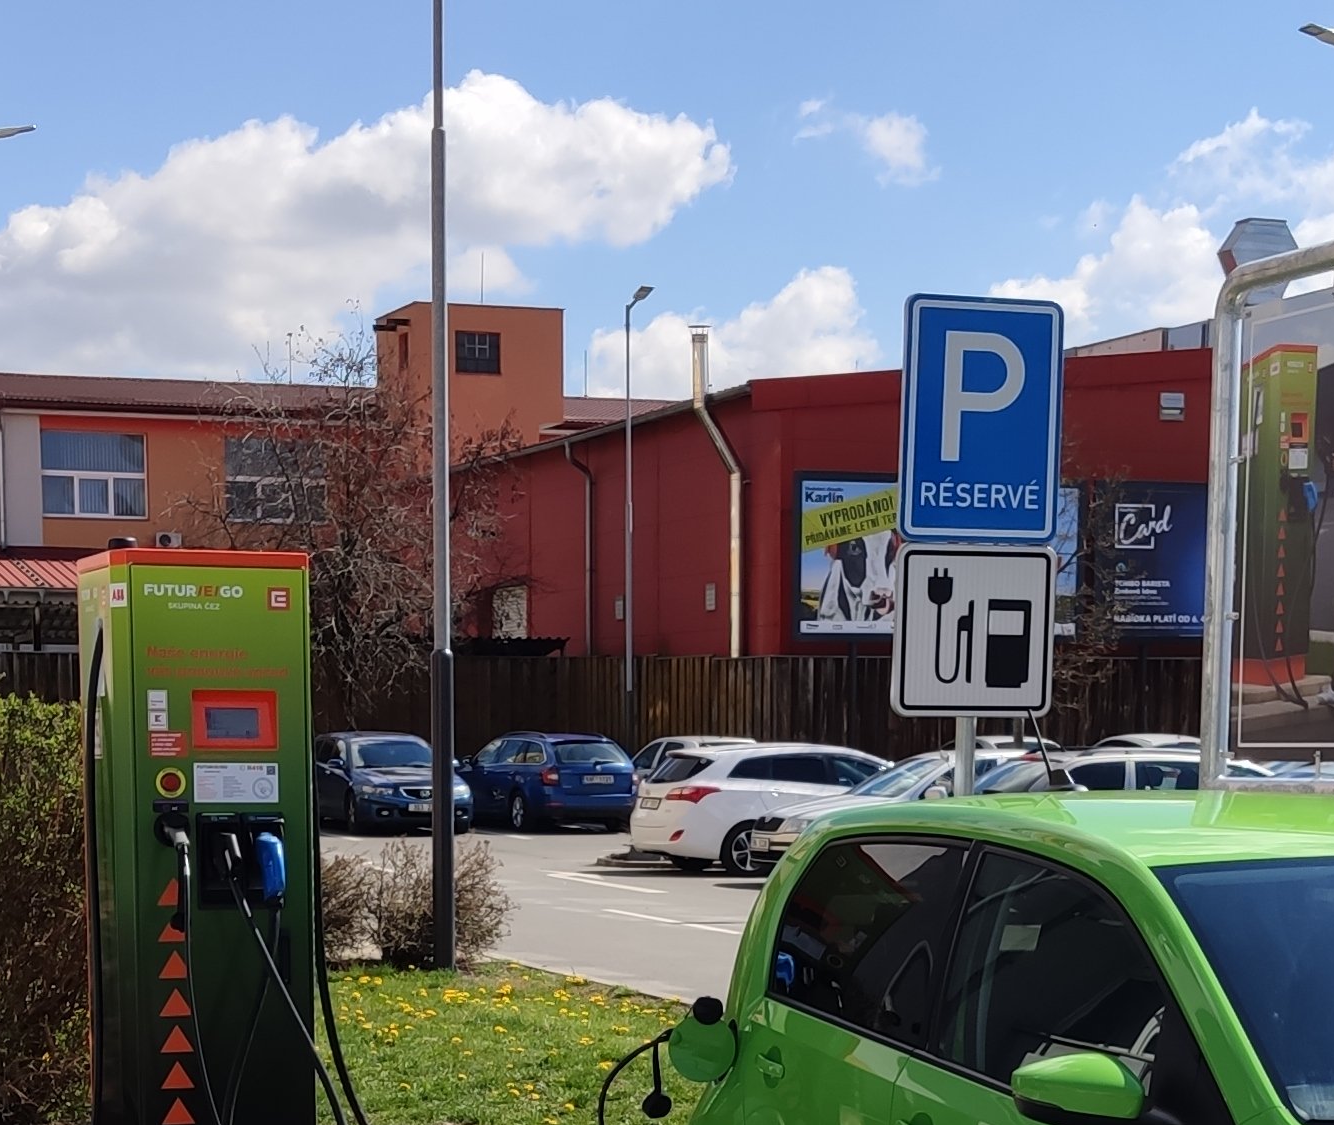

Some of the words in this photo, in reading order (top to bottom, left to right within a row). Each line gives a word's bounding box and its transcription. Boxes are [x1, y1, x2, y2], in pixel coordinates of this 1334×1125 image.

[941, 330, 1025, 462] P
[920, 477, 1040, 510] RÉSERVÉ
[855, 516, 880, 532] LETNÍ
[1119, 505, 1172, 545] Card
[168, 602, 202, 610] SKUPINA
[204, 601, 220, 611] ČEZ
[1114, 614, 1152, 623] NABÍDKA
[1153, 613, 1176, 623] PLATÍ
[1178, 615, 1190, 623] OD
